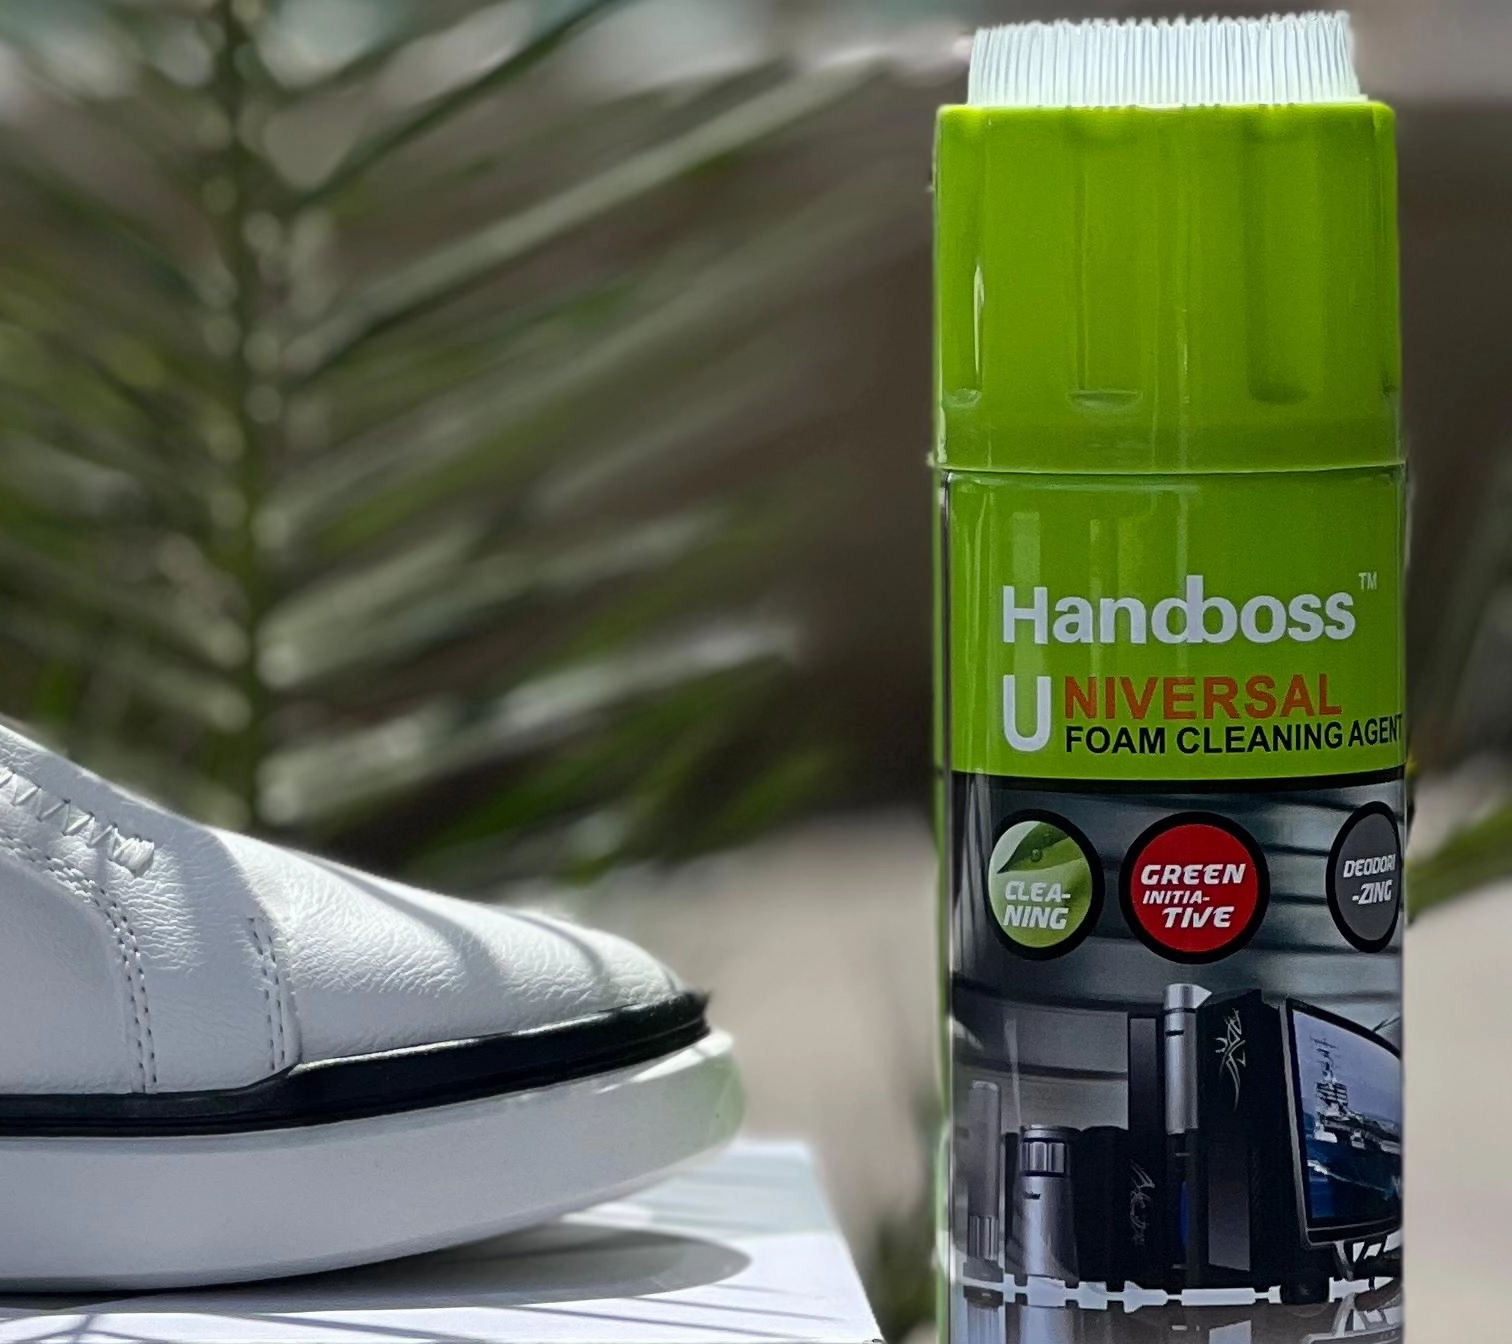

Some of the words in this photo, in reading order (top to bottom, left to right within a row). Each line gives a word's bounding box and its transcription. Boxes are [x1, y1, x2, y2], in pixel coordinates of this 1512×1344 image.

[1002, 574, 1356, 645] Handboss
[1065, 725, 1167, 754] FOAM
[1176, 720, 1344, 754] CLEANING
[1348, 712, 1403, 748] AGENT
[1140, 863, 1246, 886] GREEN
[1005, 881, 1071, 902] CLEA-
[1142, 890, 1210, 905] INITIA-
[1002, 905, 1069, 930] NING
[1161, 906, 1234, 928] TIVE
